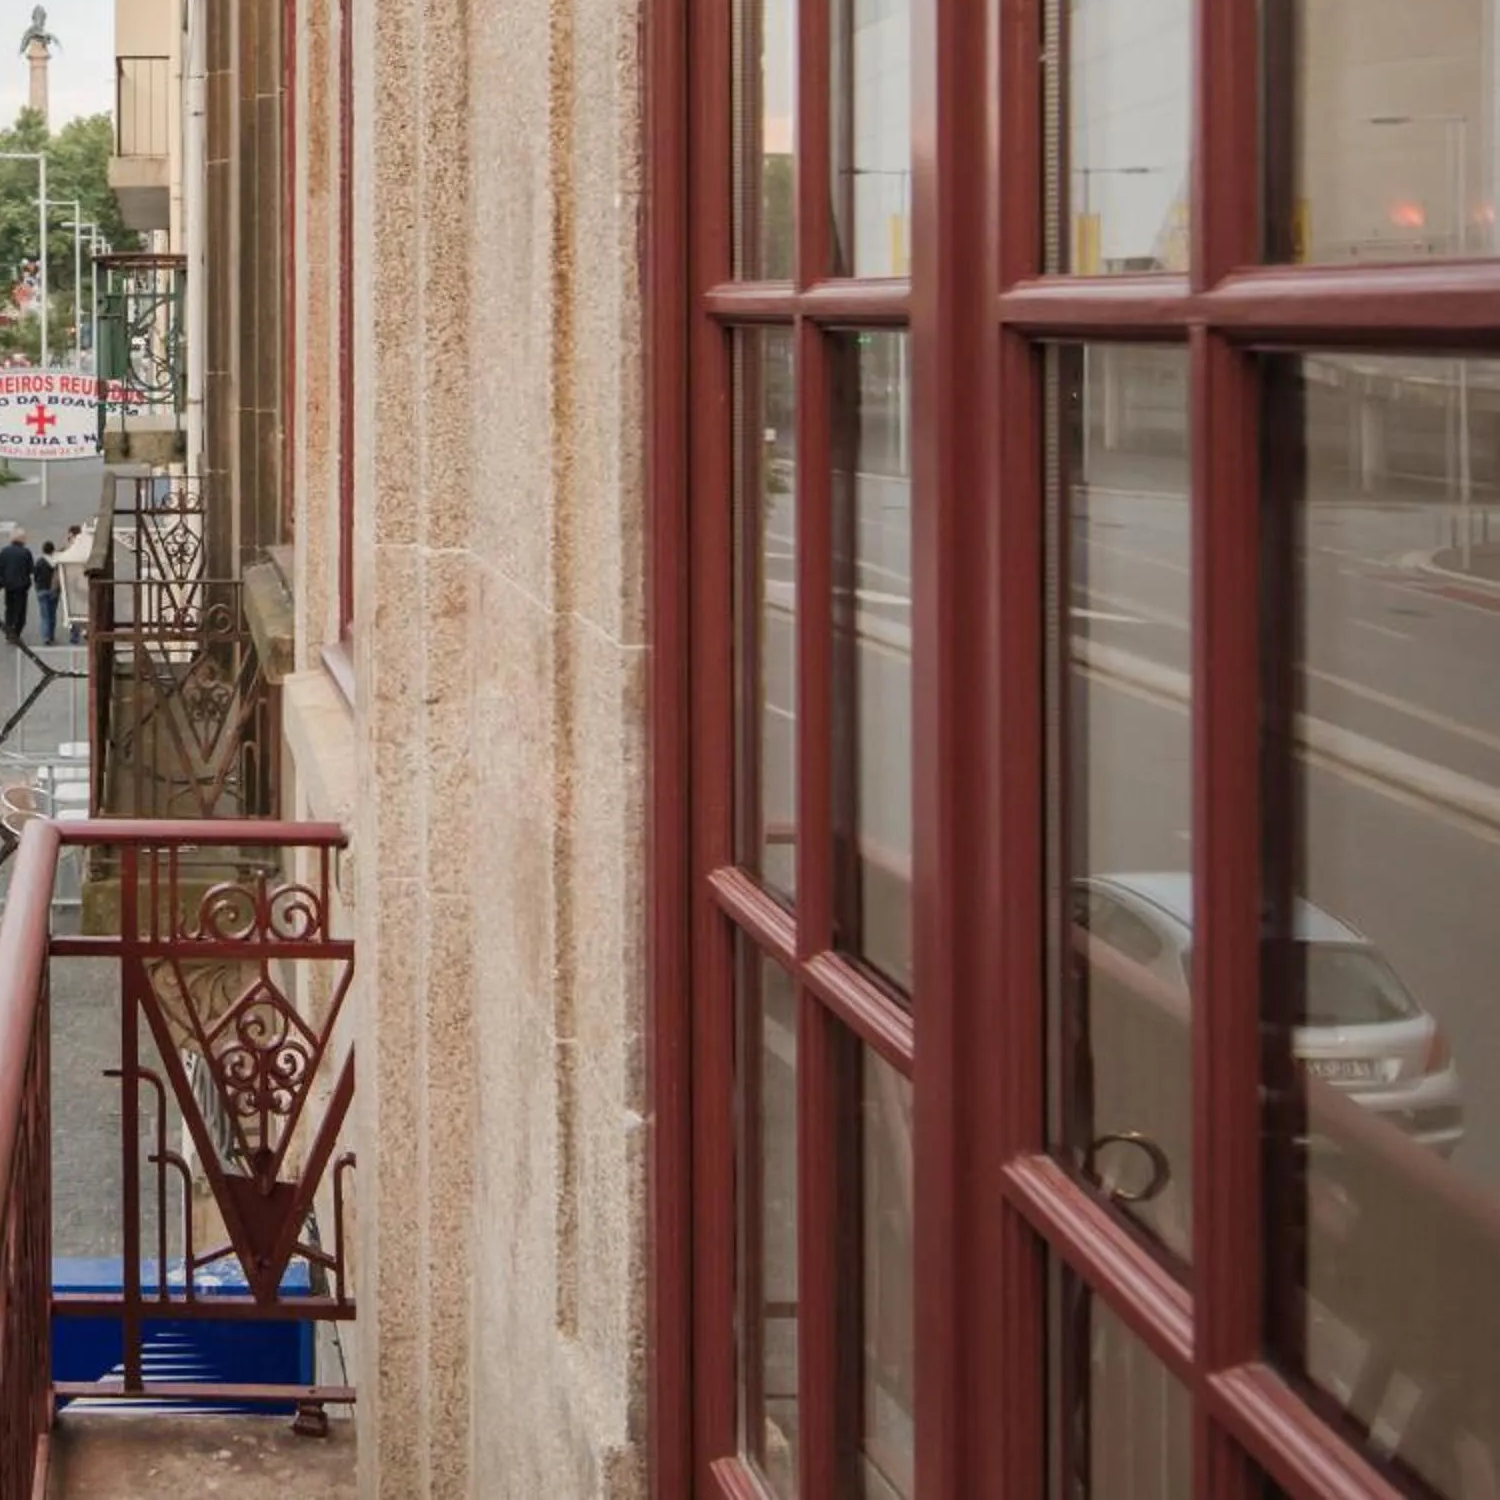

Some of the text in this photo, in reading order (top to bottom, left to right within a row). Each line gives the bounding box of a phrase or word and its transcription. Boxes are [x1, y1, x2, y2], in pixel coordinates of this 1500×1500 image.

[16, 395, 41, 405] DA
[29, 435, 61, 445] DIA
[66, 435, 77, 445] E
